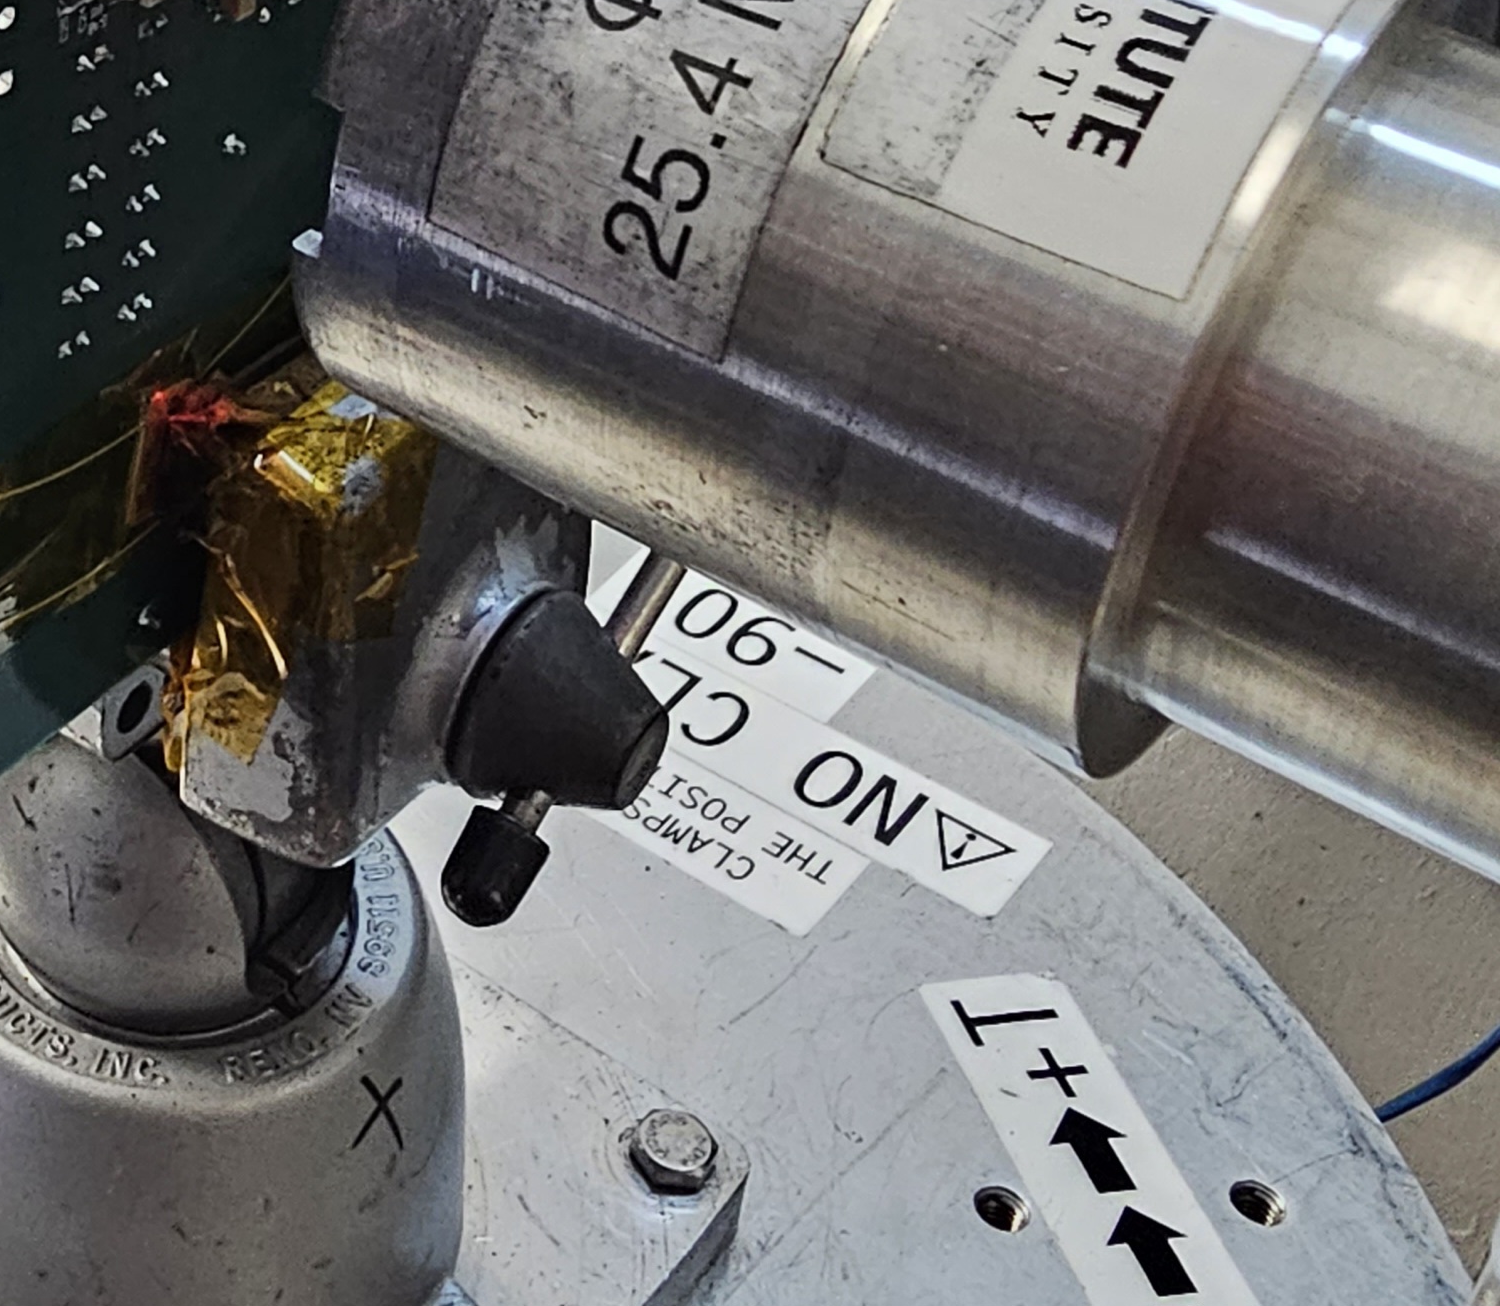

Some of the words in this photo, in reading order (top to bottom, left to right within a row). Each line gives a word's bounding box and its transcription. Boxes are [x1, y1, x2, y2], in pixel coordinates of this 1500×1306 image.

[603, 49, 754, 281] 25.4
[673, 587, 846, 675] -90
[635, 650, 750, 747] CL
[622, 797, 756, 881] CLAMPS
[649, 767, 751, 835] POSI
[793, 750, 931, 847] NO
[760, 830, 835, 886] THE
